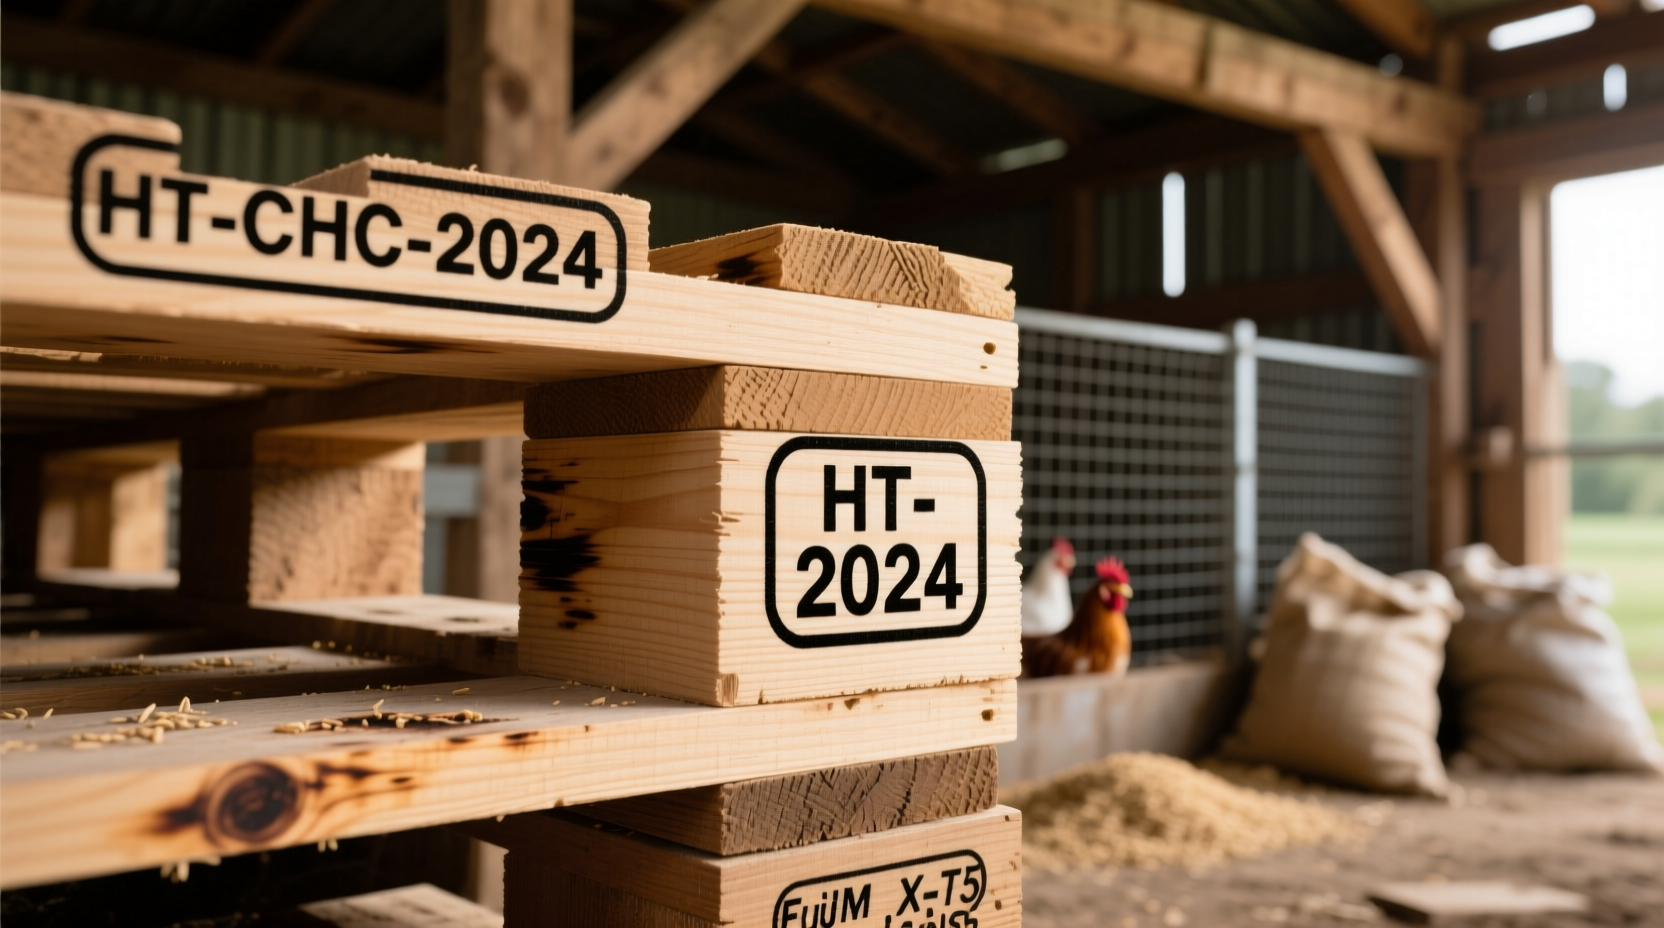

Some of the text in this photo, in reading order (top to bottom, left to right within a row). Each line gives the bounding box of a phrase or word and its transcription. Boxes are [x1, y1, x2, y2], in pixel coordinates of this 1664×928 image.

[98, 168, 603, 290] HT-CHC-2024
[823, 464, 936, 532] HT-
[796, 542, 964, 618] 2024
[896, 865, 980, 916] X-T5
